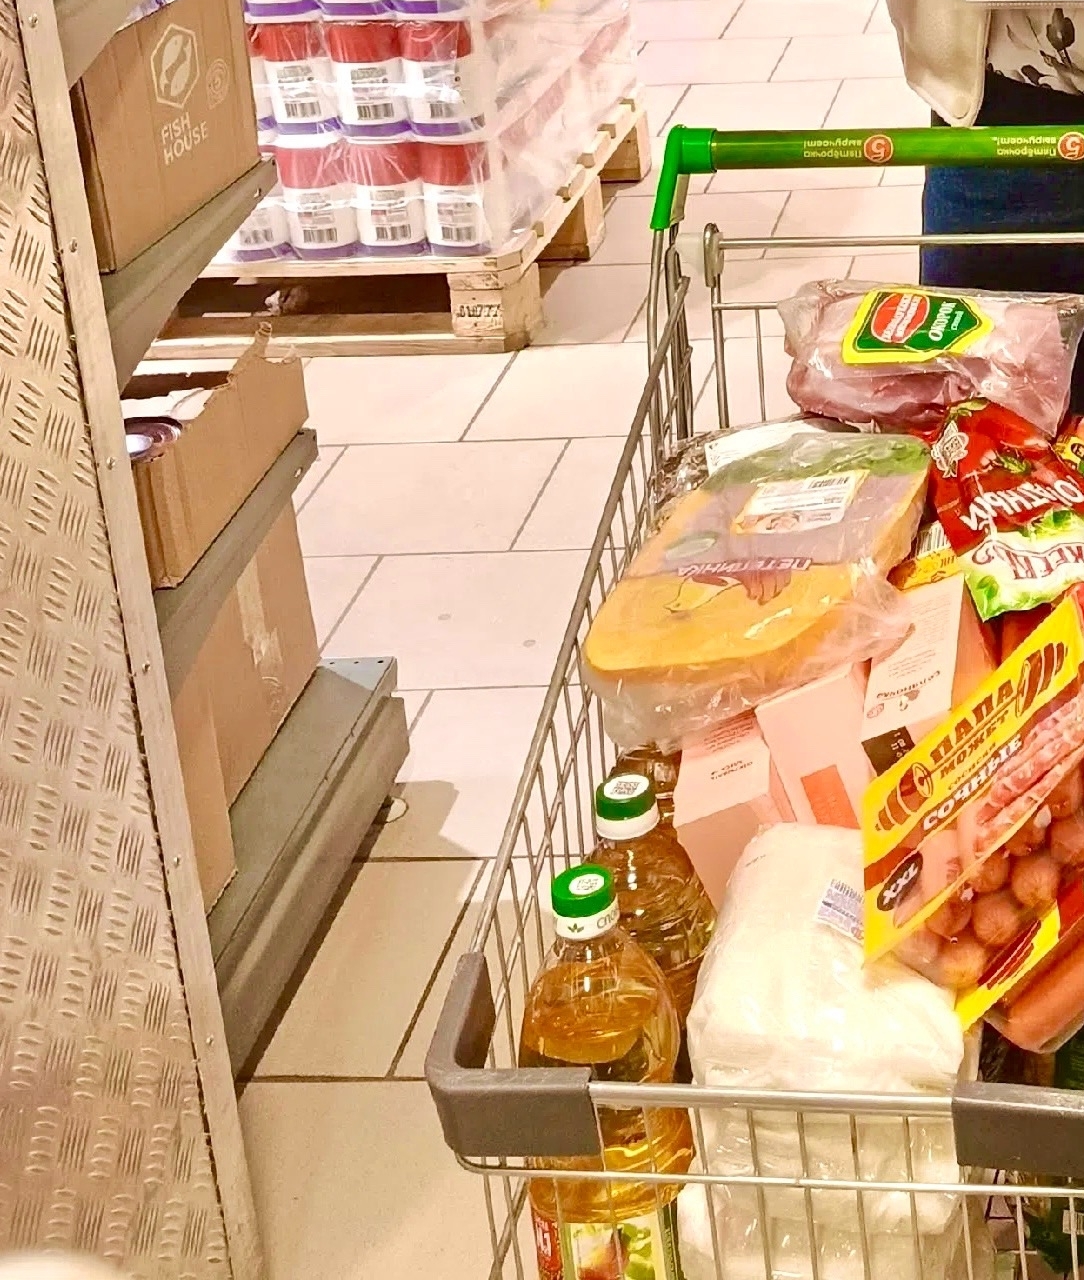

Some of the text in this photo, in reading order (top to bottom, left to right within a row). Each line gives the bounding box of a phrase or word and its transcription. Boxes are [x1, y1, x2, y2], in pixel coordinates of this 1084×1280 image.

[161, 112, 191, 144] FISH
[163, 121, 208, 165] HOUSE
[804, 149, 862, 159] Пятёрочка
[997, 146, 1056, 157] Пятёрочка
[928, 300, 957, 341] ОКОРОК
[930, 679, 1014, 765] ПАПА
[940, 710, 1009, 780] МОЖЕТ
[923, 734, 1023, 831] СОЧНЫЕ
[883, 862, 920, 905] XXL
